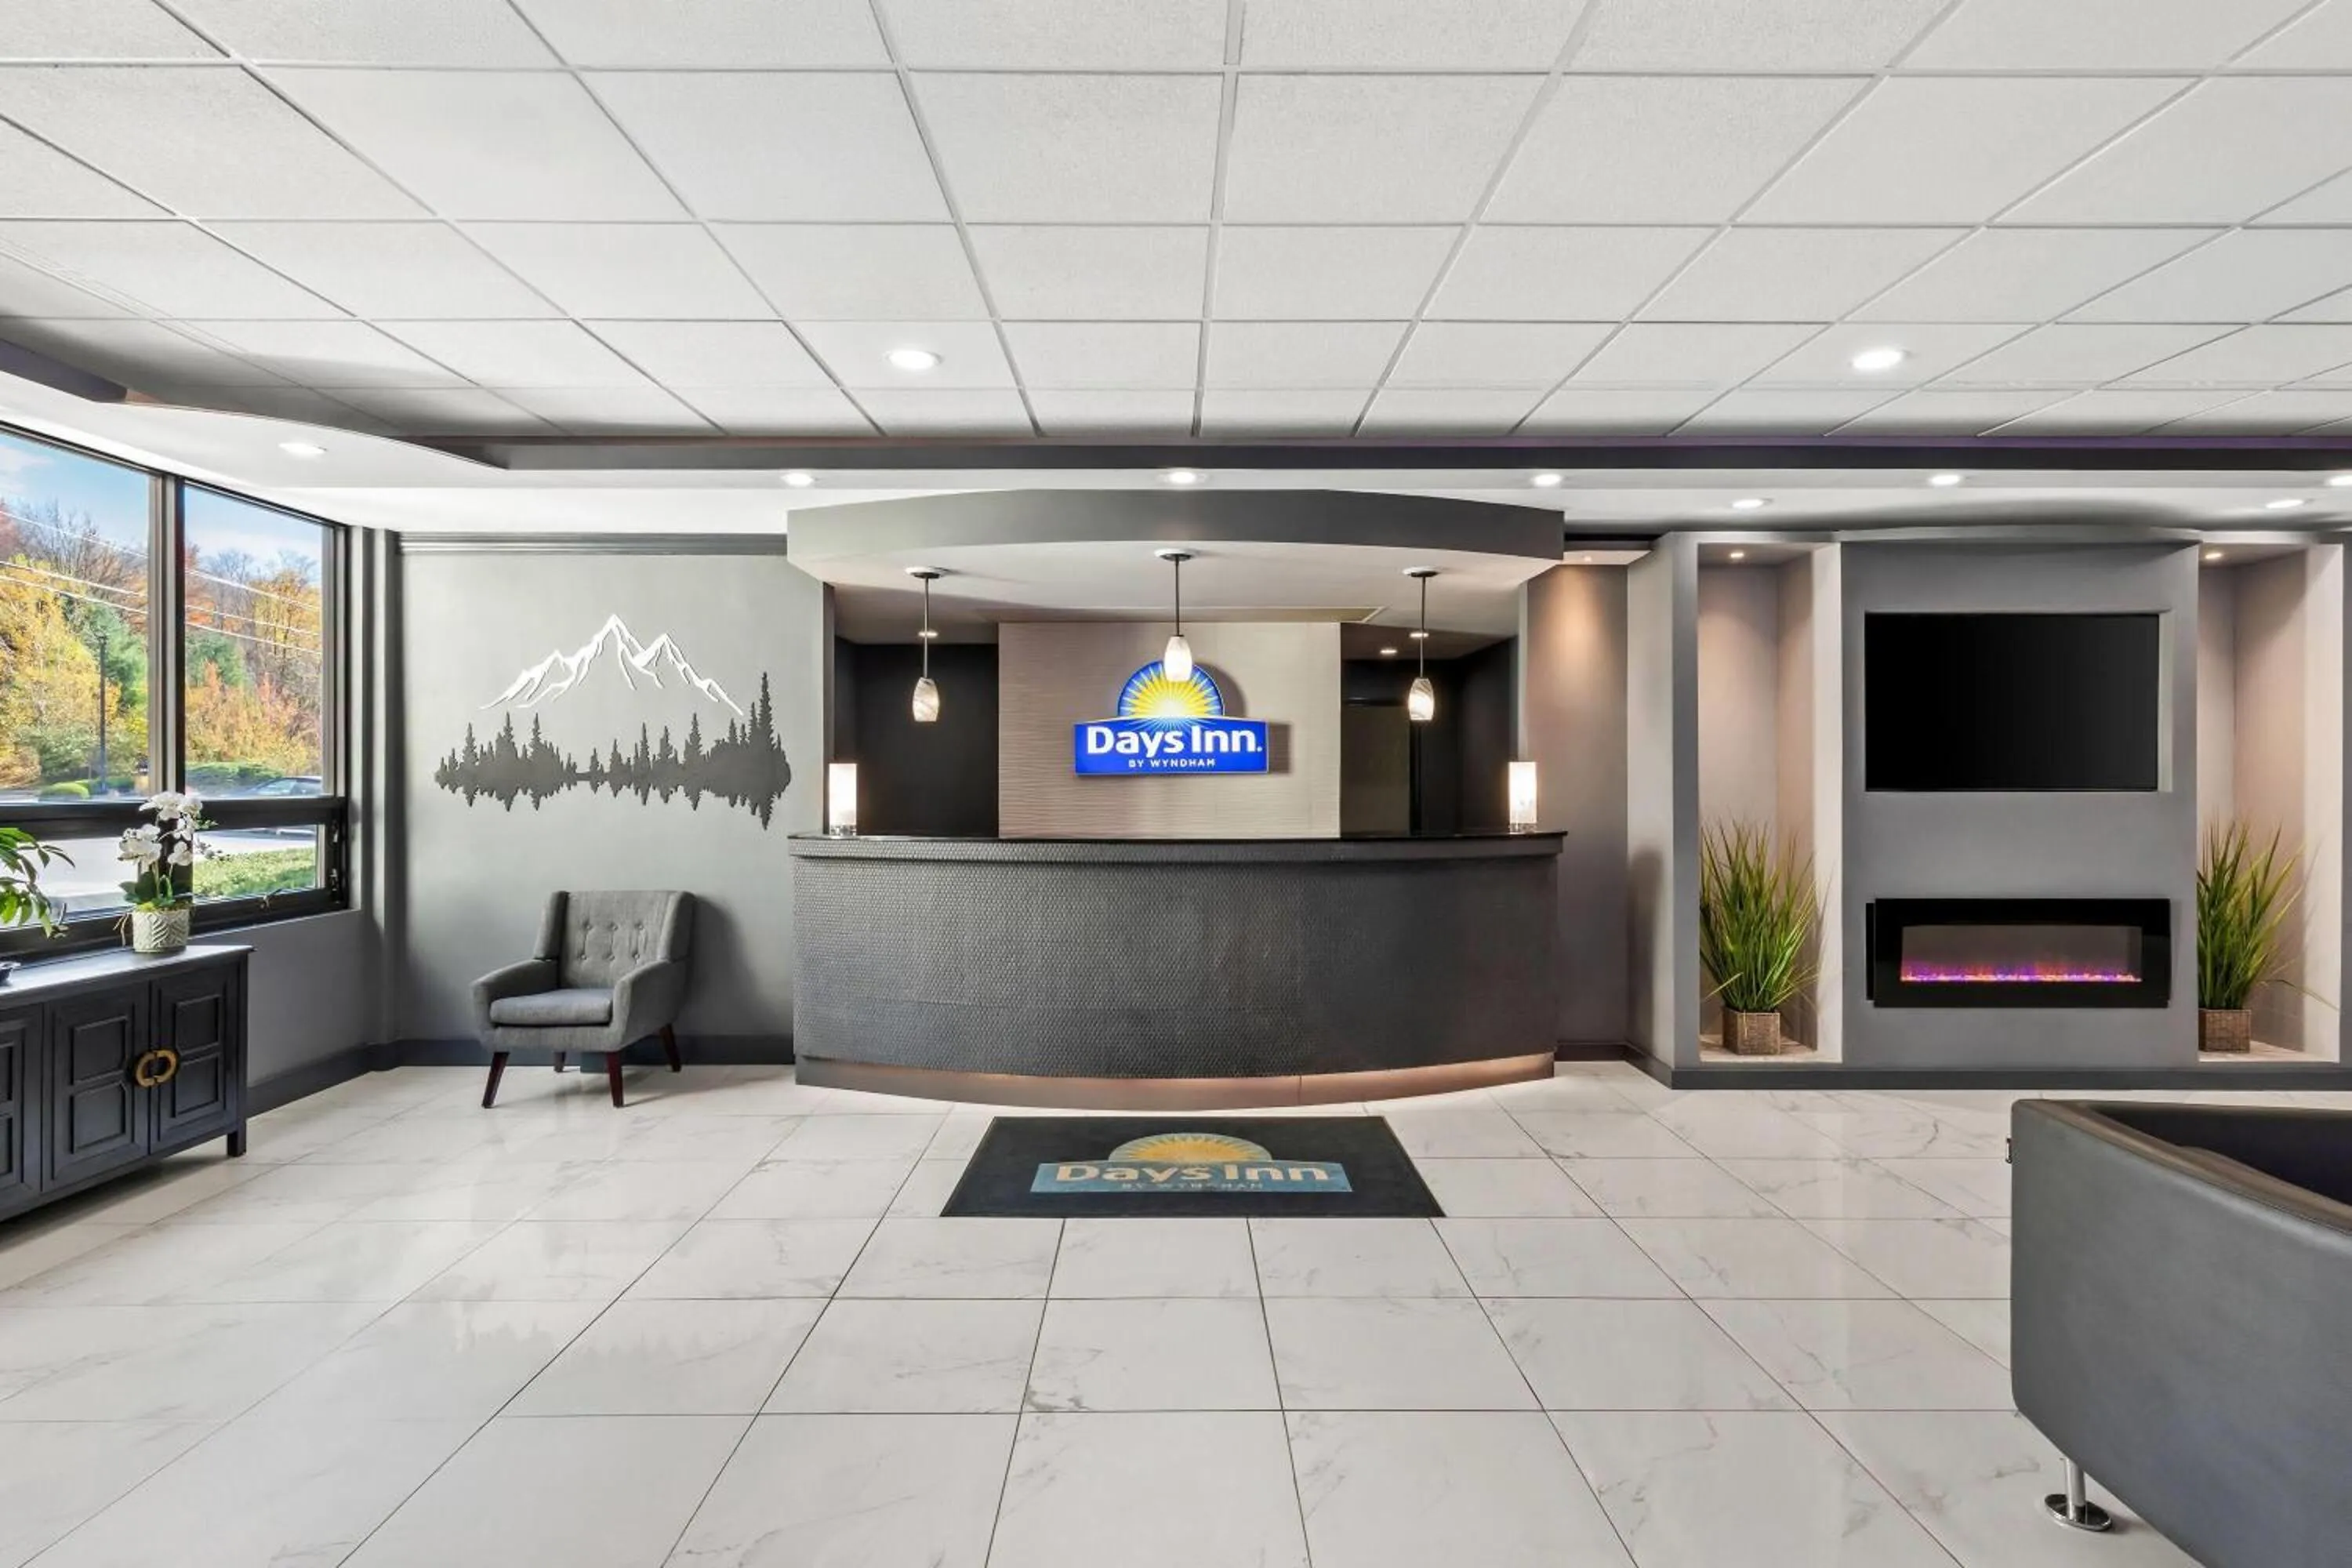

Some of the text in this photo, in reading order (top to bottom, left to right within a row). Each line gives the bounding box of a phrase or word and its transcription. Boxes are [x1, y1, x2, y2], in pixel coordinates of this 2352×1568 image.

[1087, 726, 1185, 757] Days
[1129, 758, 1215, 768] BY WYNDHAM
[1056, 1164, 1329, 1183] Days Inn
